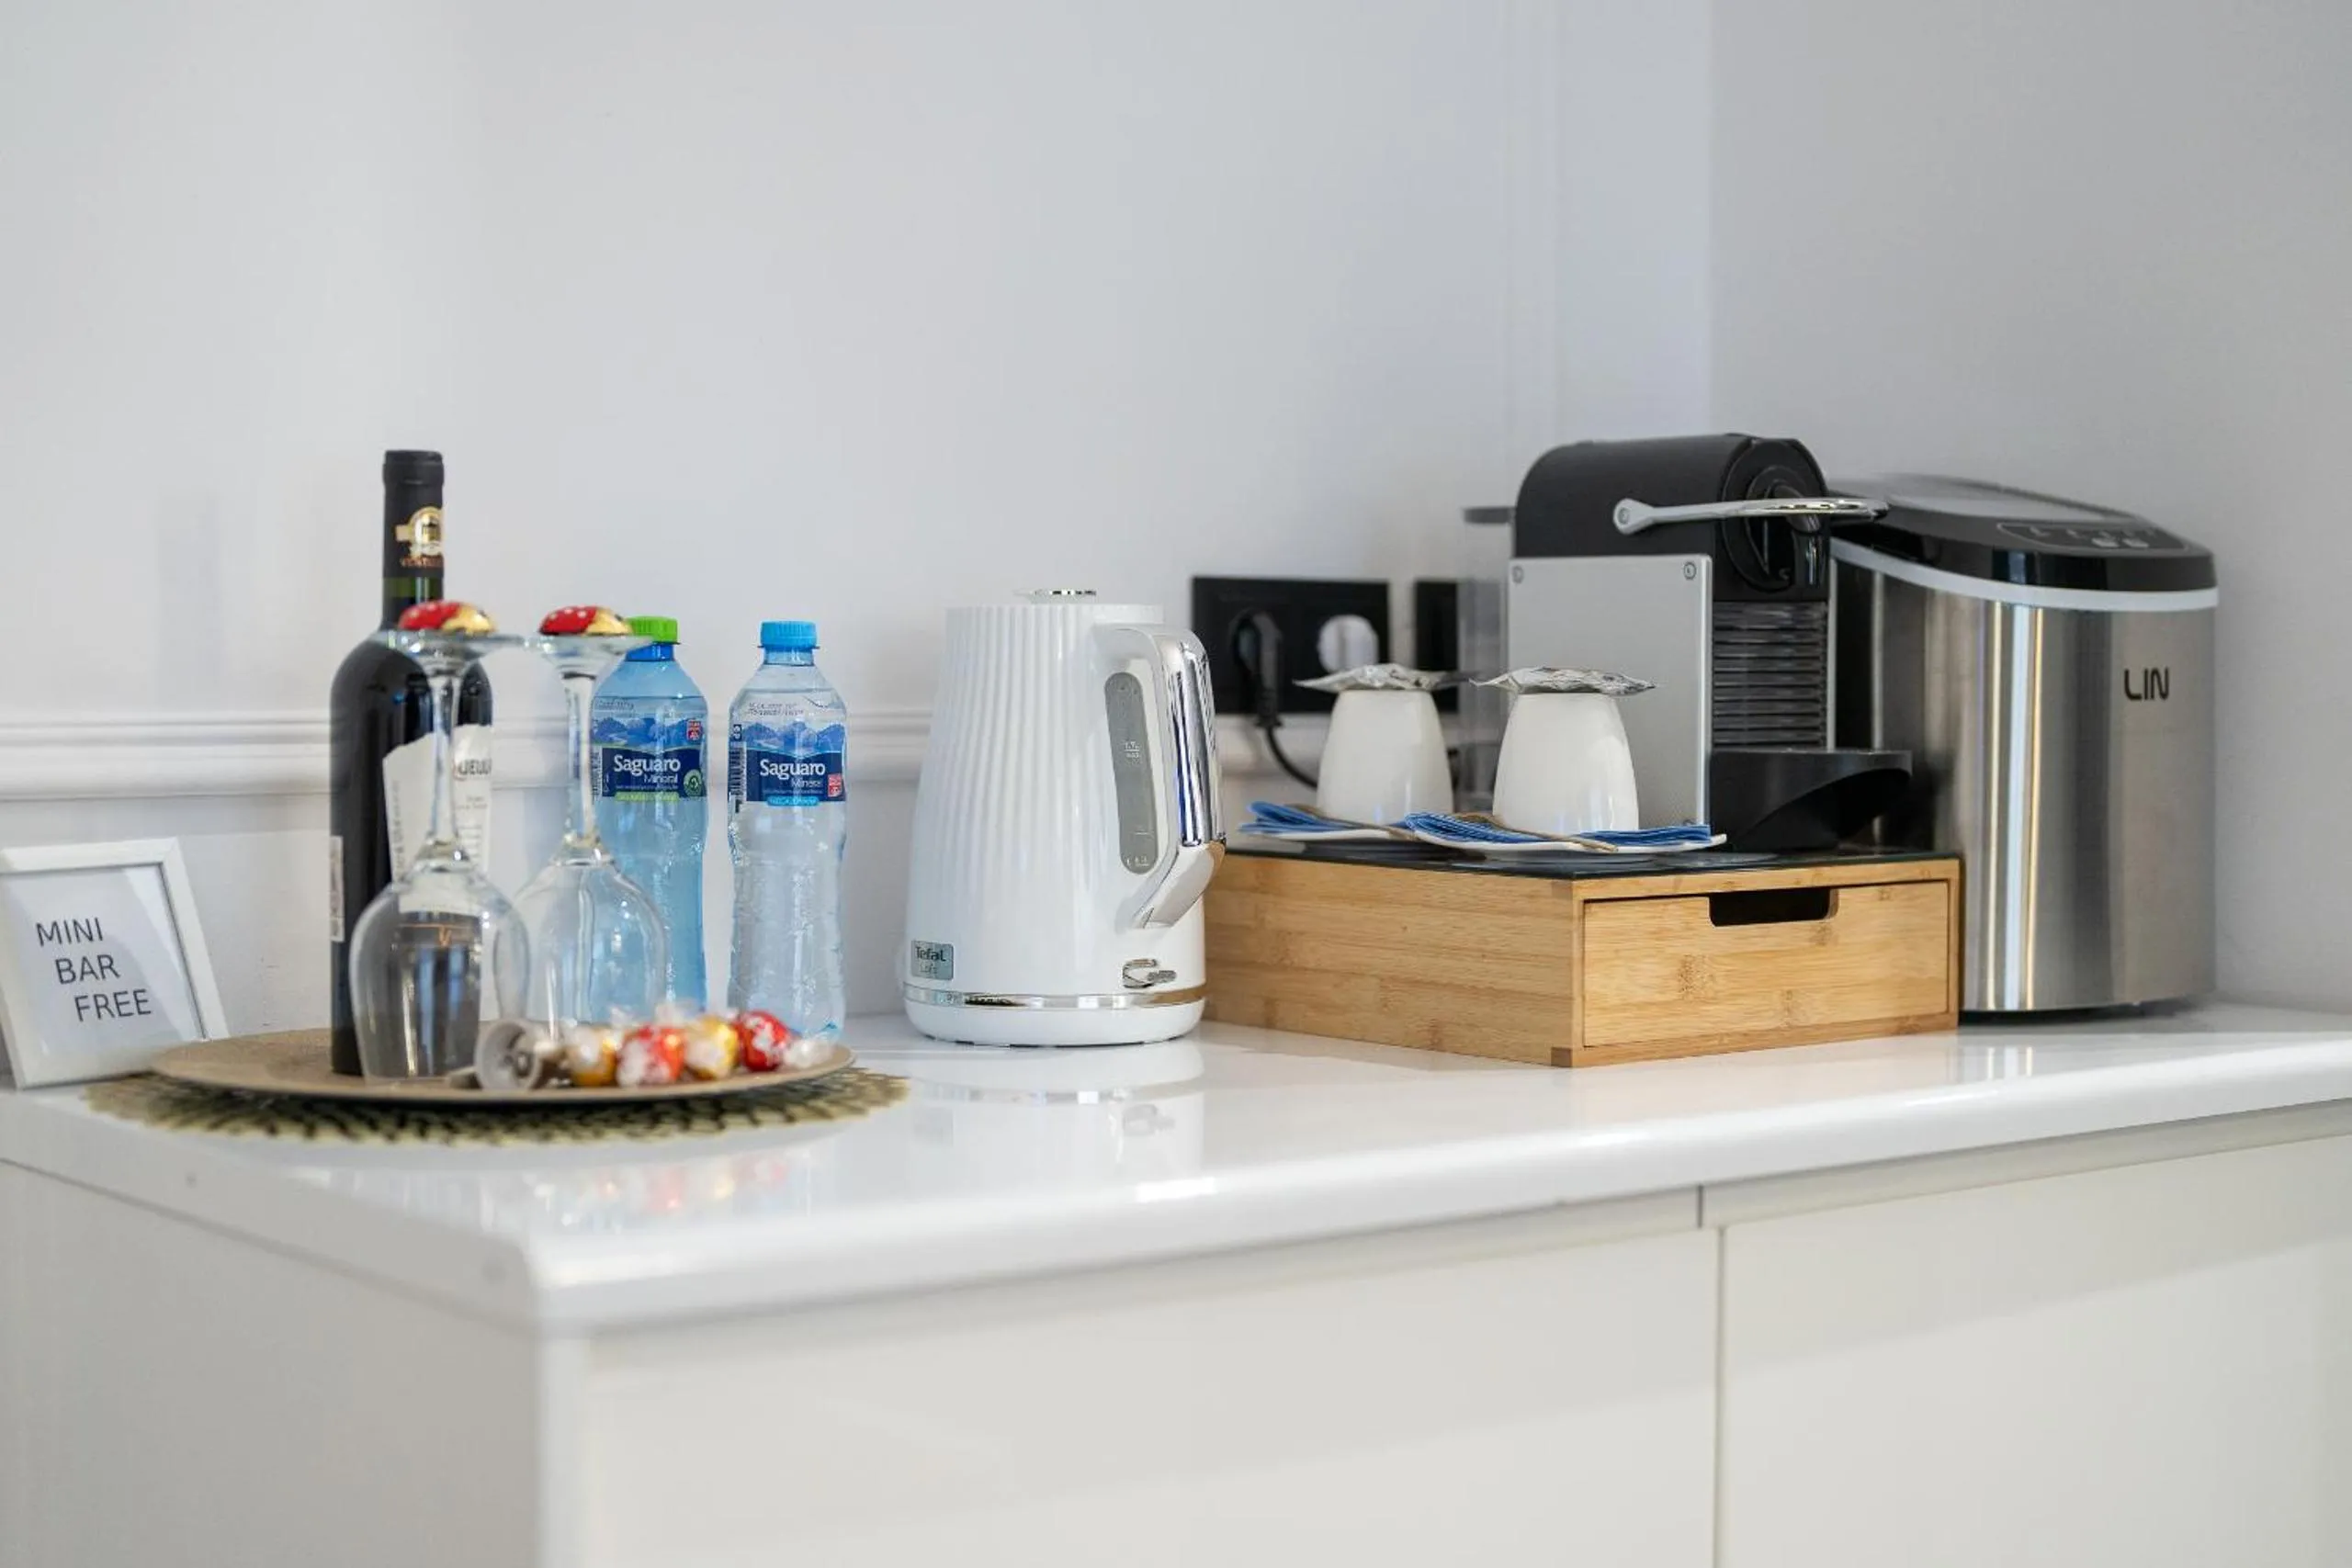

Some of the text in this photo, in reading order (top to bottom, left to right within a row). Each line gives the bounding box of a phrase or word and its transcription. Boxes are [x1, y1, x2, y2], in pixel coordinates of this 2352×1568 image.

[2124, 667, 2169, 701] LIN
[614, 754, 681, 777] Saguaro
[760, 759, 826, 780] Saguaro
[36, 917, 104, 947] MINI
[55, 953, 120, 985] BAR
[915, 946, 946, 962] Tefal
[74, 988, 153, 1022] FREE
